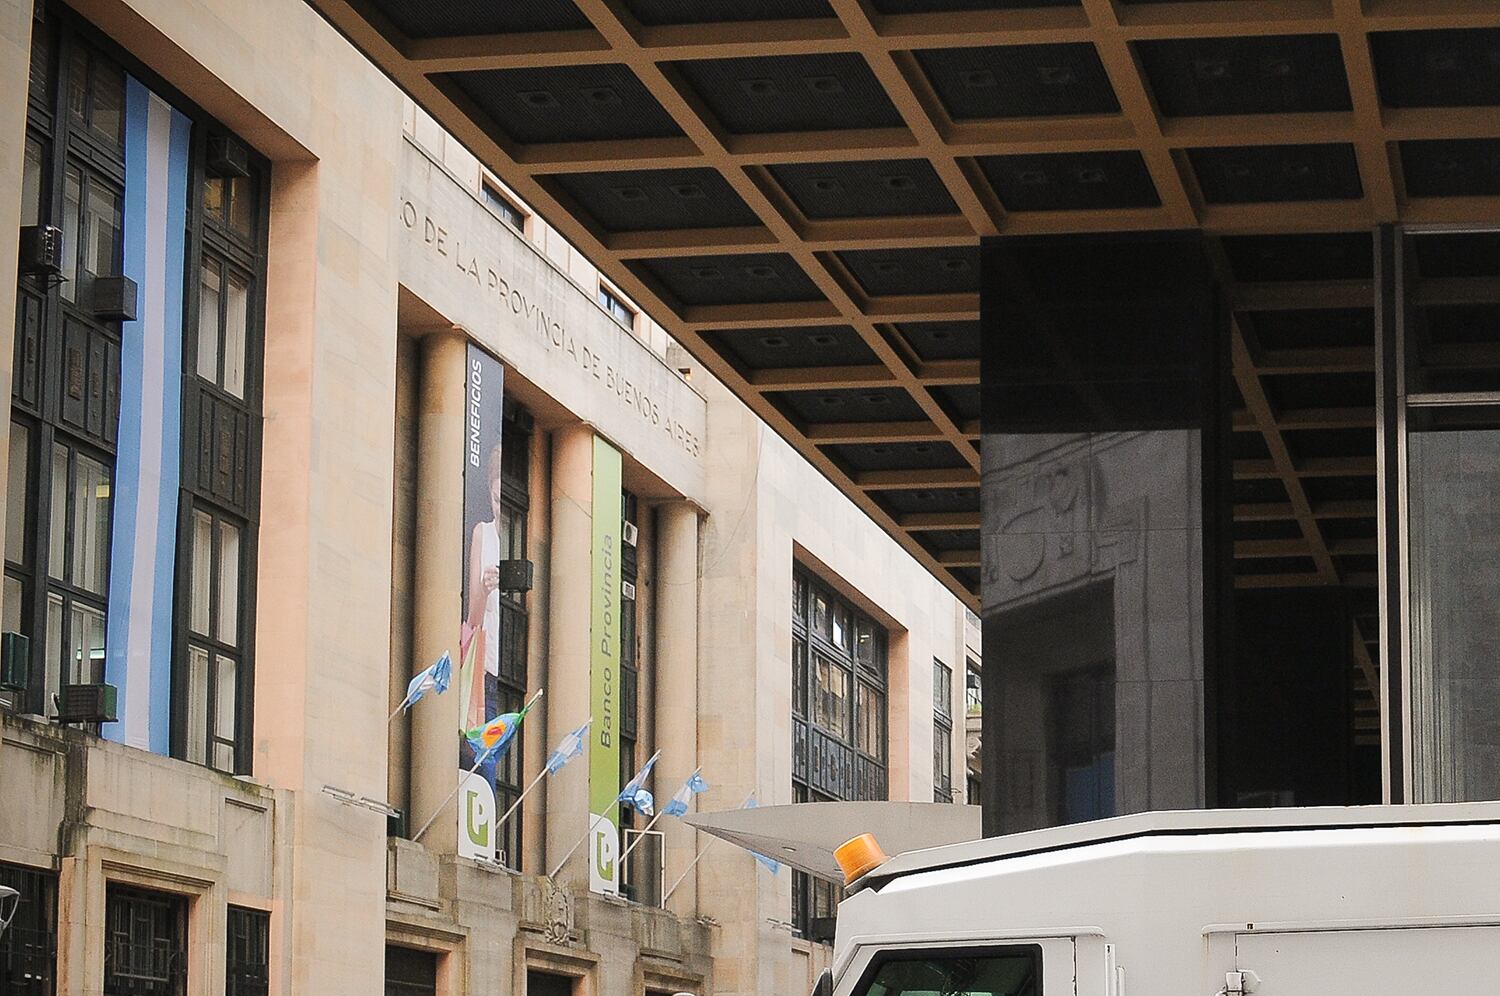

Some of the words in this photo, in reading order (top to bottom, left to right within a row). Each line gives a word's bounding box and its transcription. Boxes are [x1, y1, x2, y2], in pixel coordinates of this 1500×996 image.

[424, 216, 449, 257] DE
[456, 242, 482, 288] LA
[487, 267, 579, 362] PROVINCIA
[582, 346, 602, 379] DE
[606, 365, 661, 425] BUENOS
[664, 417, 700, 458] AIRES
[470, 359, 483, 468] BENEFICIOS
[601, 534, 614, 657] Provincia
[600, 667, 613, 749] Banco
